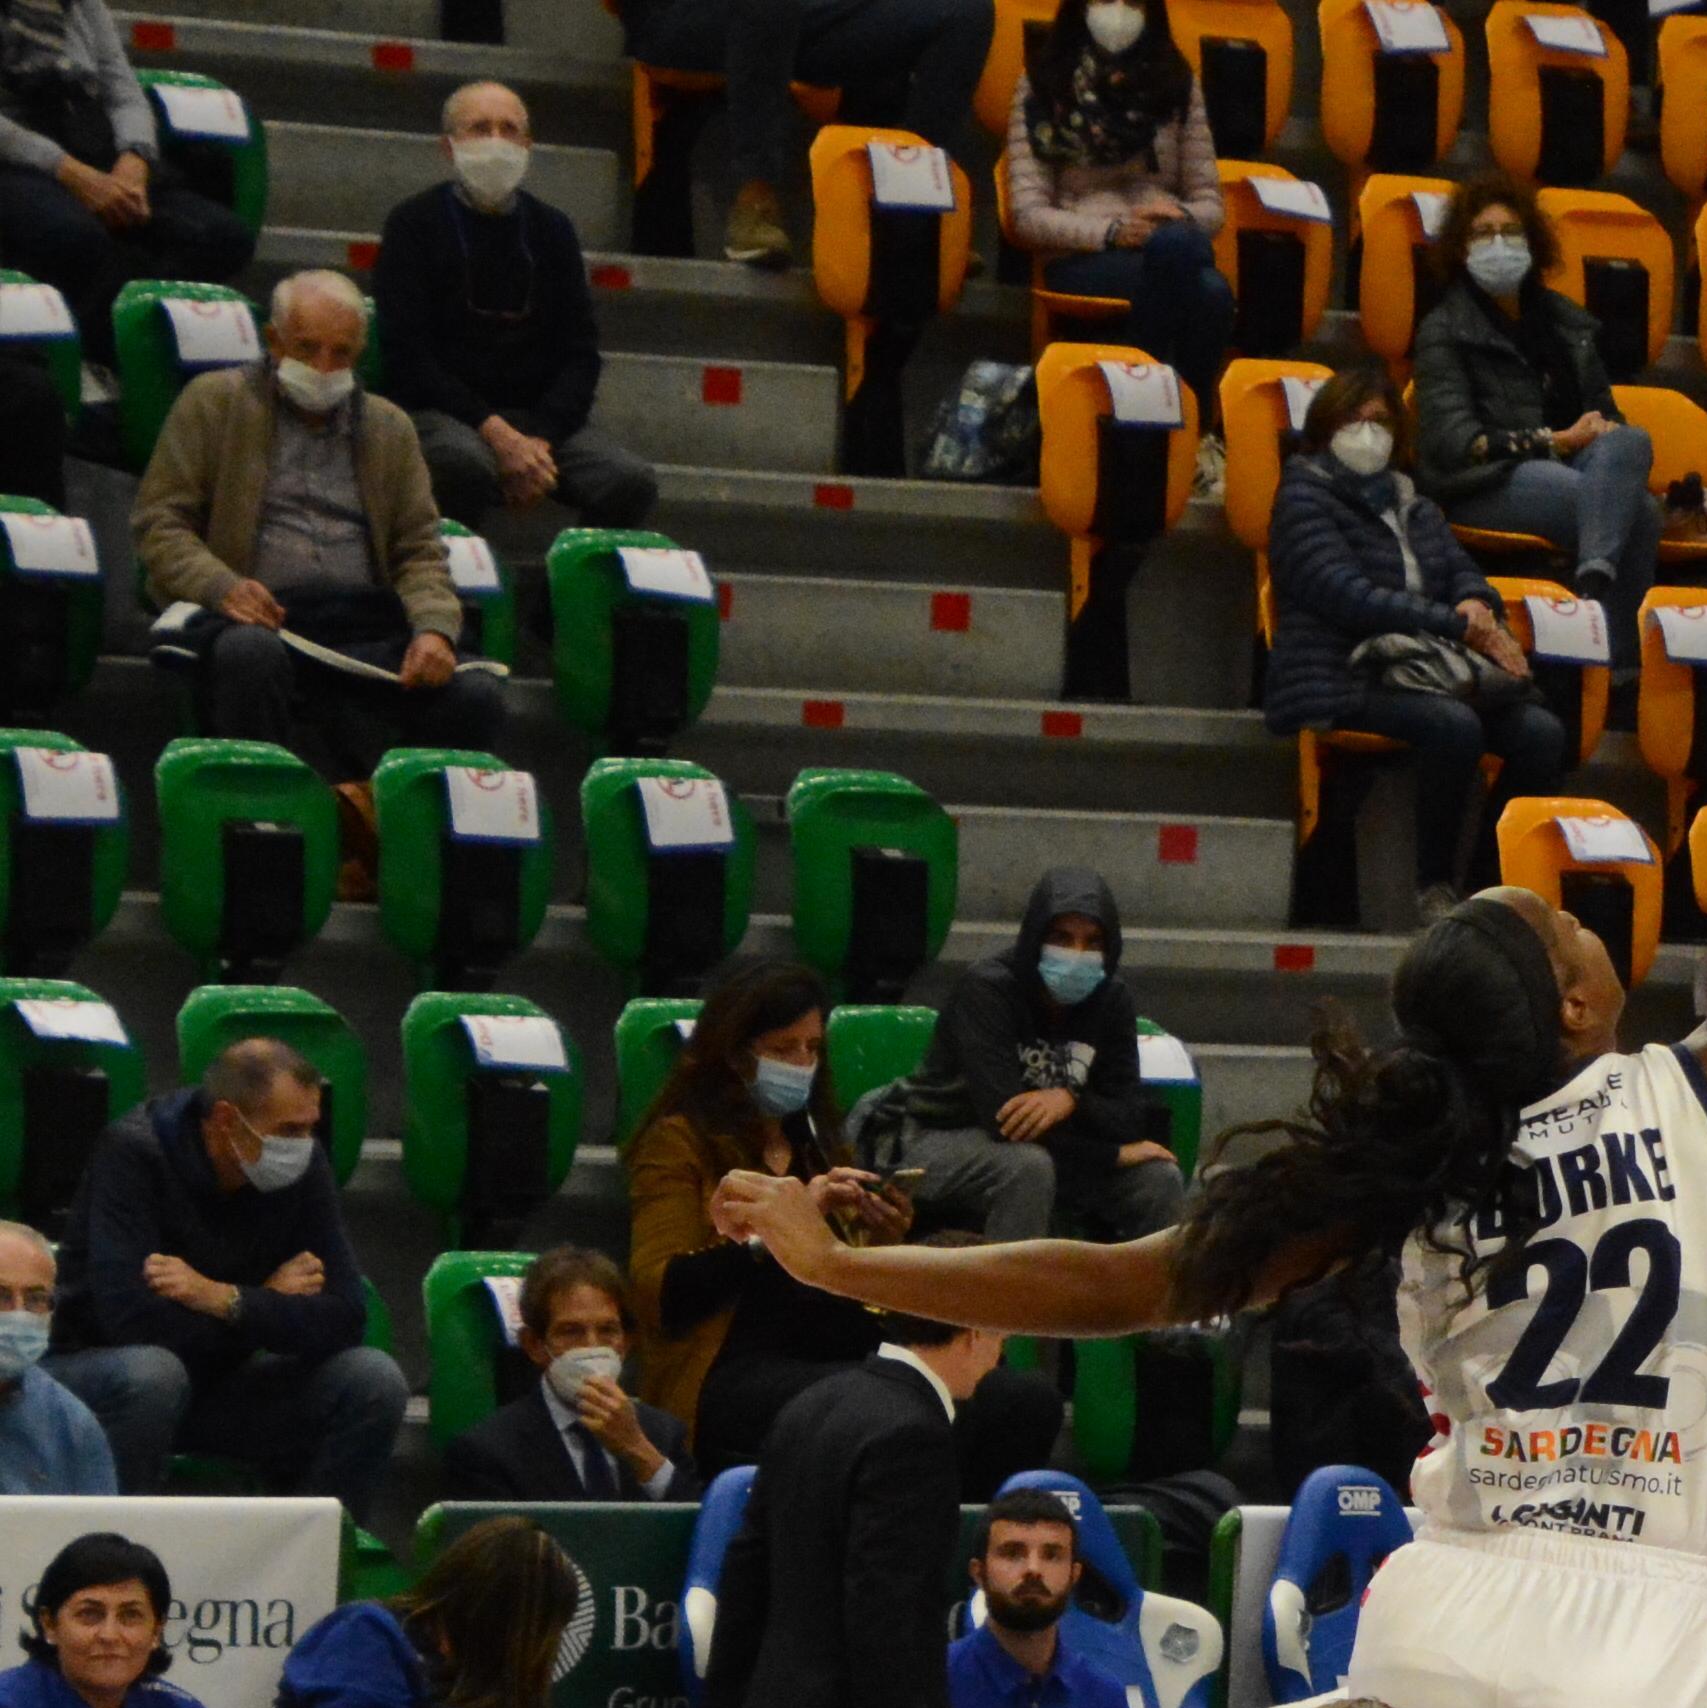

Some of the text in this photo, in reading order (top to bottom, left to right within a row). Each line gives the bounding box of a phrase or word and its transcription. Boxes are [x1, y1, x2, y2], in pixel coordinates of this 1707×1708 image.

[1485, 1218, 1682, 1412] 22
[1480, 1423, 1682, 1465] SARDEGNA
[1338, 1491, 1382, 1511] OMP
